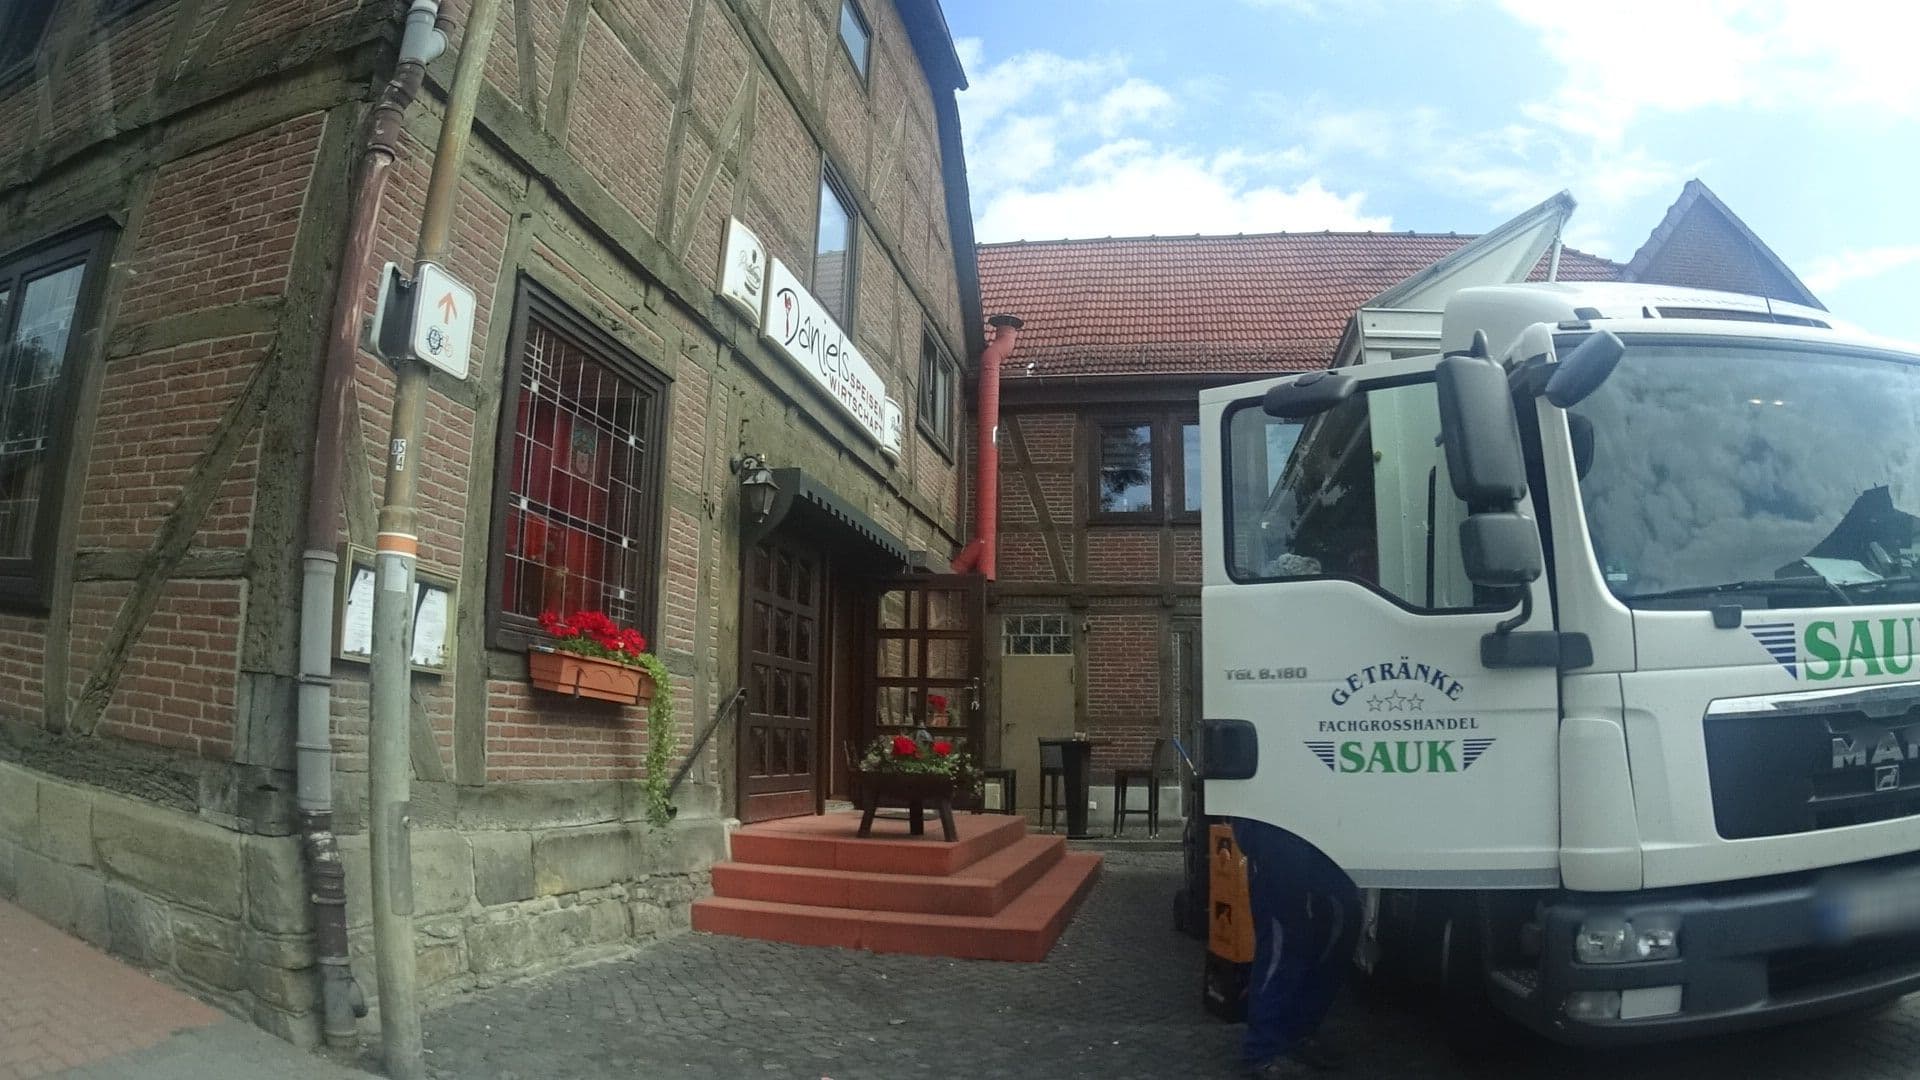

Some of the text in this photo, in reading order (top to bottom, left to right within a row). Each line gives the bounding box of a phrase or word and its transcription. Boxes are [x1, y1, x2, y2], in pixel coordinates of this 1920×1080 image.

[829, 373, 883, 438] WIRTSCHAFT
[850, 372, 883, 421] SPEISEN
[1259, 666, 1307, 680] 8.180
[1803, 617, 1920, 681] SAU
[1331, 656, 1464, 706] GETRÄNKE
[1319, 717, 1479, 732] FACHGROSSHANDEL
[1339, 740, 1458, 773] SAUK
